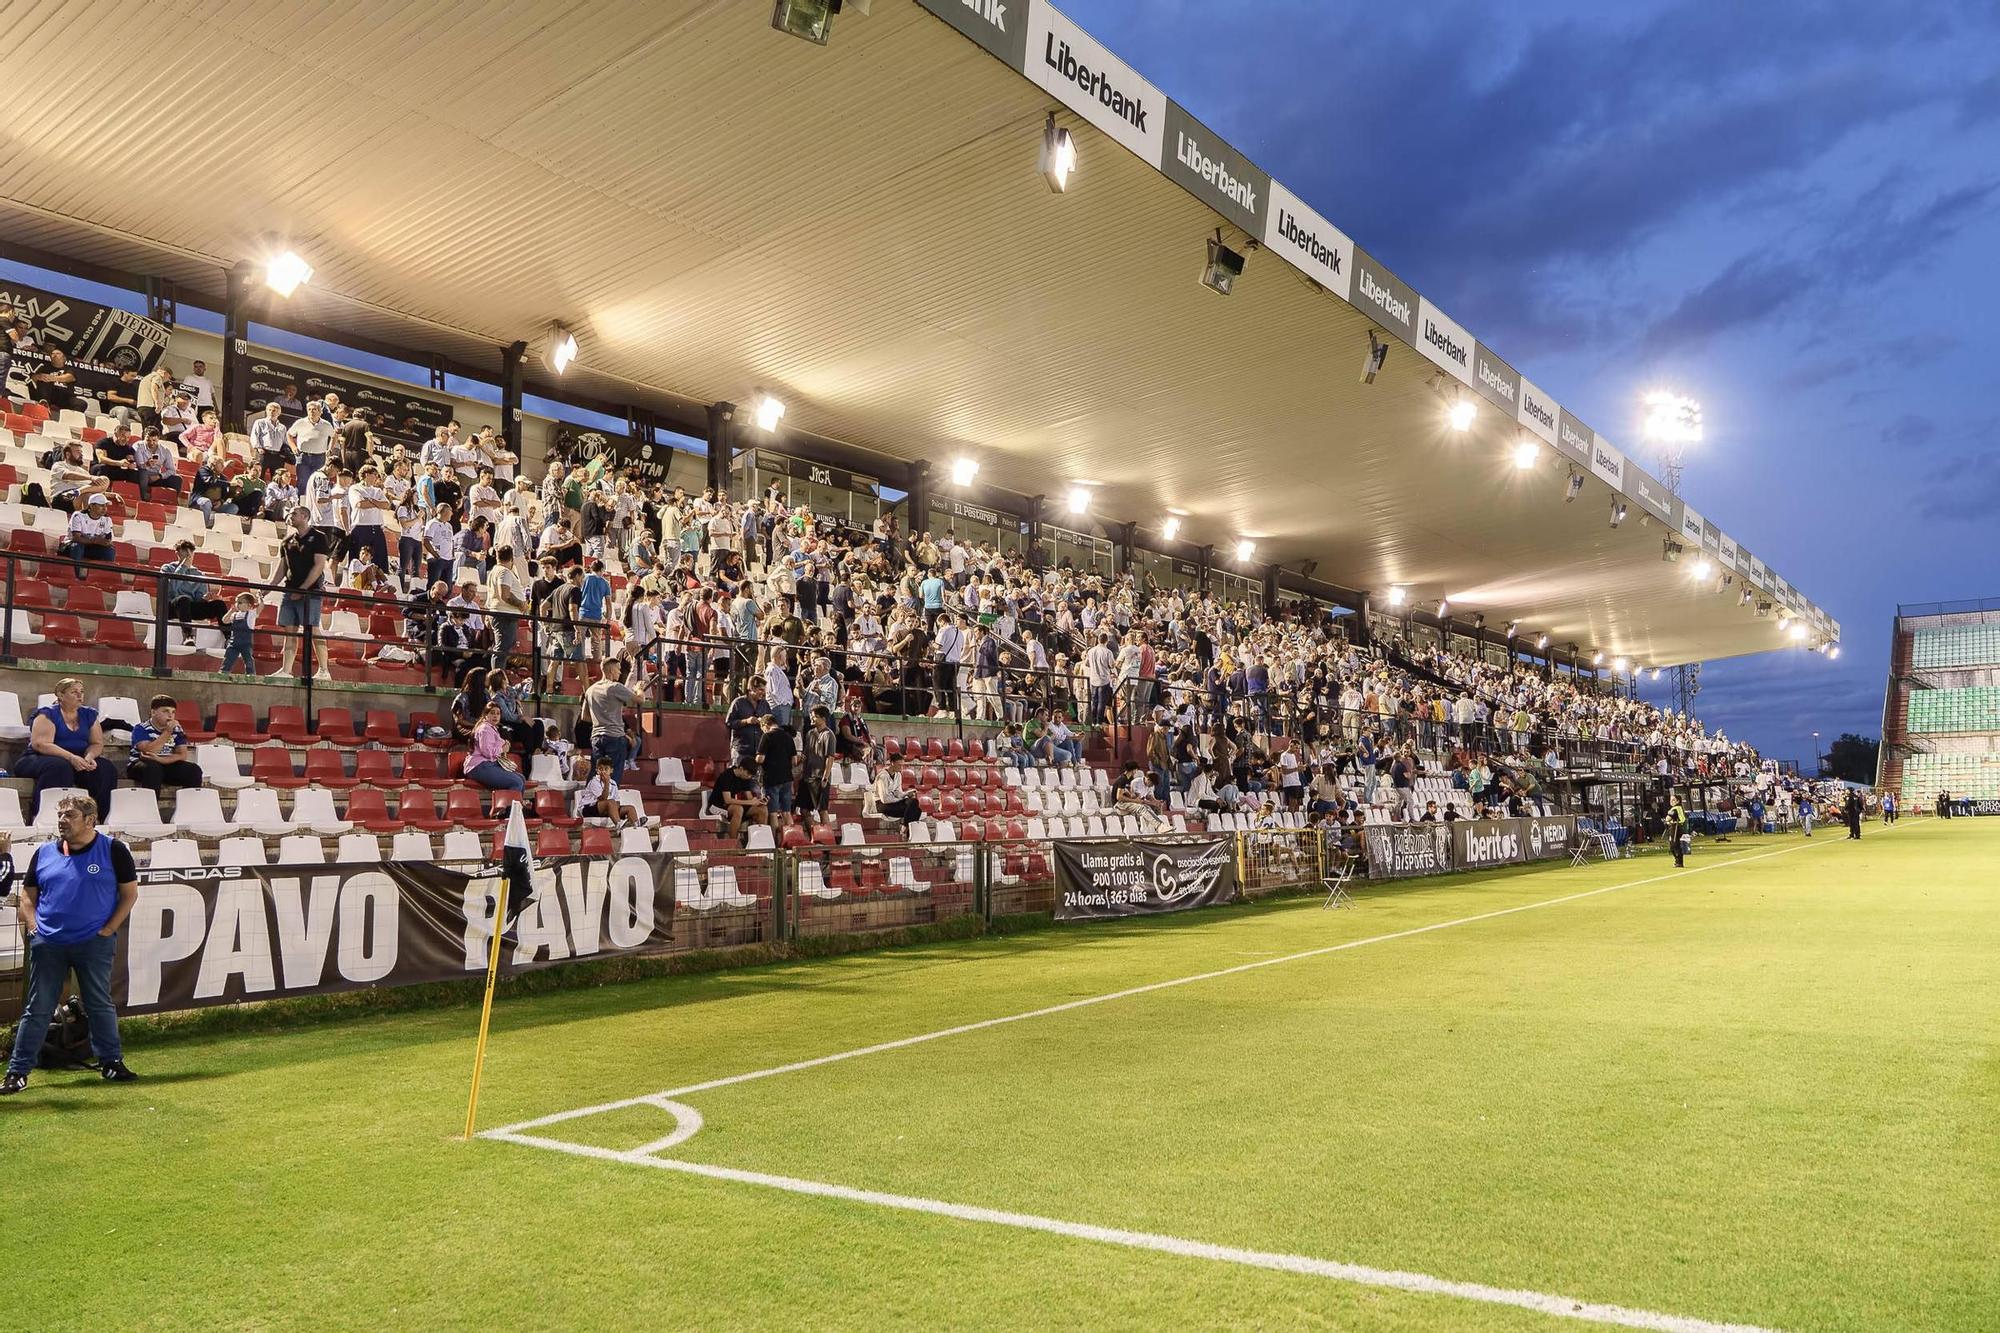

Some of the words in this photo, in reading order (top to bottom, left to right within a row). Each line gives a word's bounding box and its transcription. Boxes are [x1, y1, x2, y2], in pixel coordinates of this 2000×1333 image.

[1045, 31, 1147, 134] Liberbank
[1176, 130, 1257, 214] Liberbank
[1277, 208, 1342, 275] Liberbank
[1359, 268, 1411, 327] Liberbank
[114, 311, 169, 347] MERIDA
[1424, 318, 1468, 368] Liberbank
[1479, 358, 1515, 402] Liberbank
[1523, 393, 1555, 431] Liberbank
[373, 443, 394, 454] rutas
[1562, 422, 1590, 456] Liberbank
[1595, 448, 1620, 478] Liberbank
[816, 513, 837, 524] NUNCA
[1393, 829, 1434, 855] MÉRIDA
[1466, 826, 1519, 862] Iberitos
[1543, 823, 1568, 843] MÉRIDA
[136, 867, 242, 883] TIENDAS
[1081, 852, 1109, 869] Llama
[1110, 852, 1135, 871] gratis
[1136, 851, 1145, 867] al
[1092, 872, 1111, 887] 900
[1111, 871, 1128, 886] 100
[1129, 870, 1145, 885] 036
[462, 856, 656, 971] PAVO
[1064, 891, 1078, 907] 24
[1078, 890, 1106, 907] horas
[1110, 890, 1128, 905] 365
[127, 871, 400, 1007] PAVO
